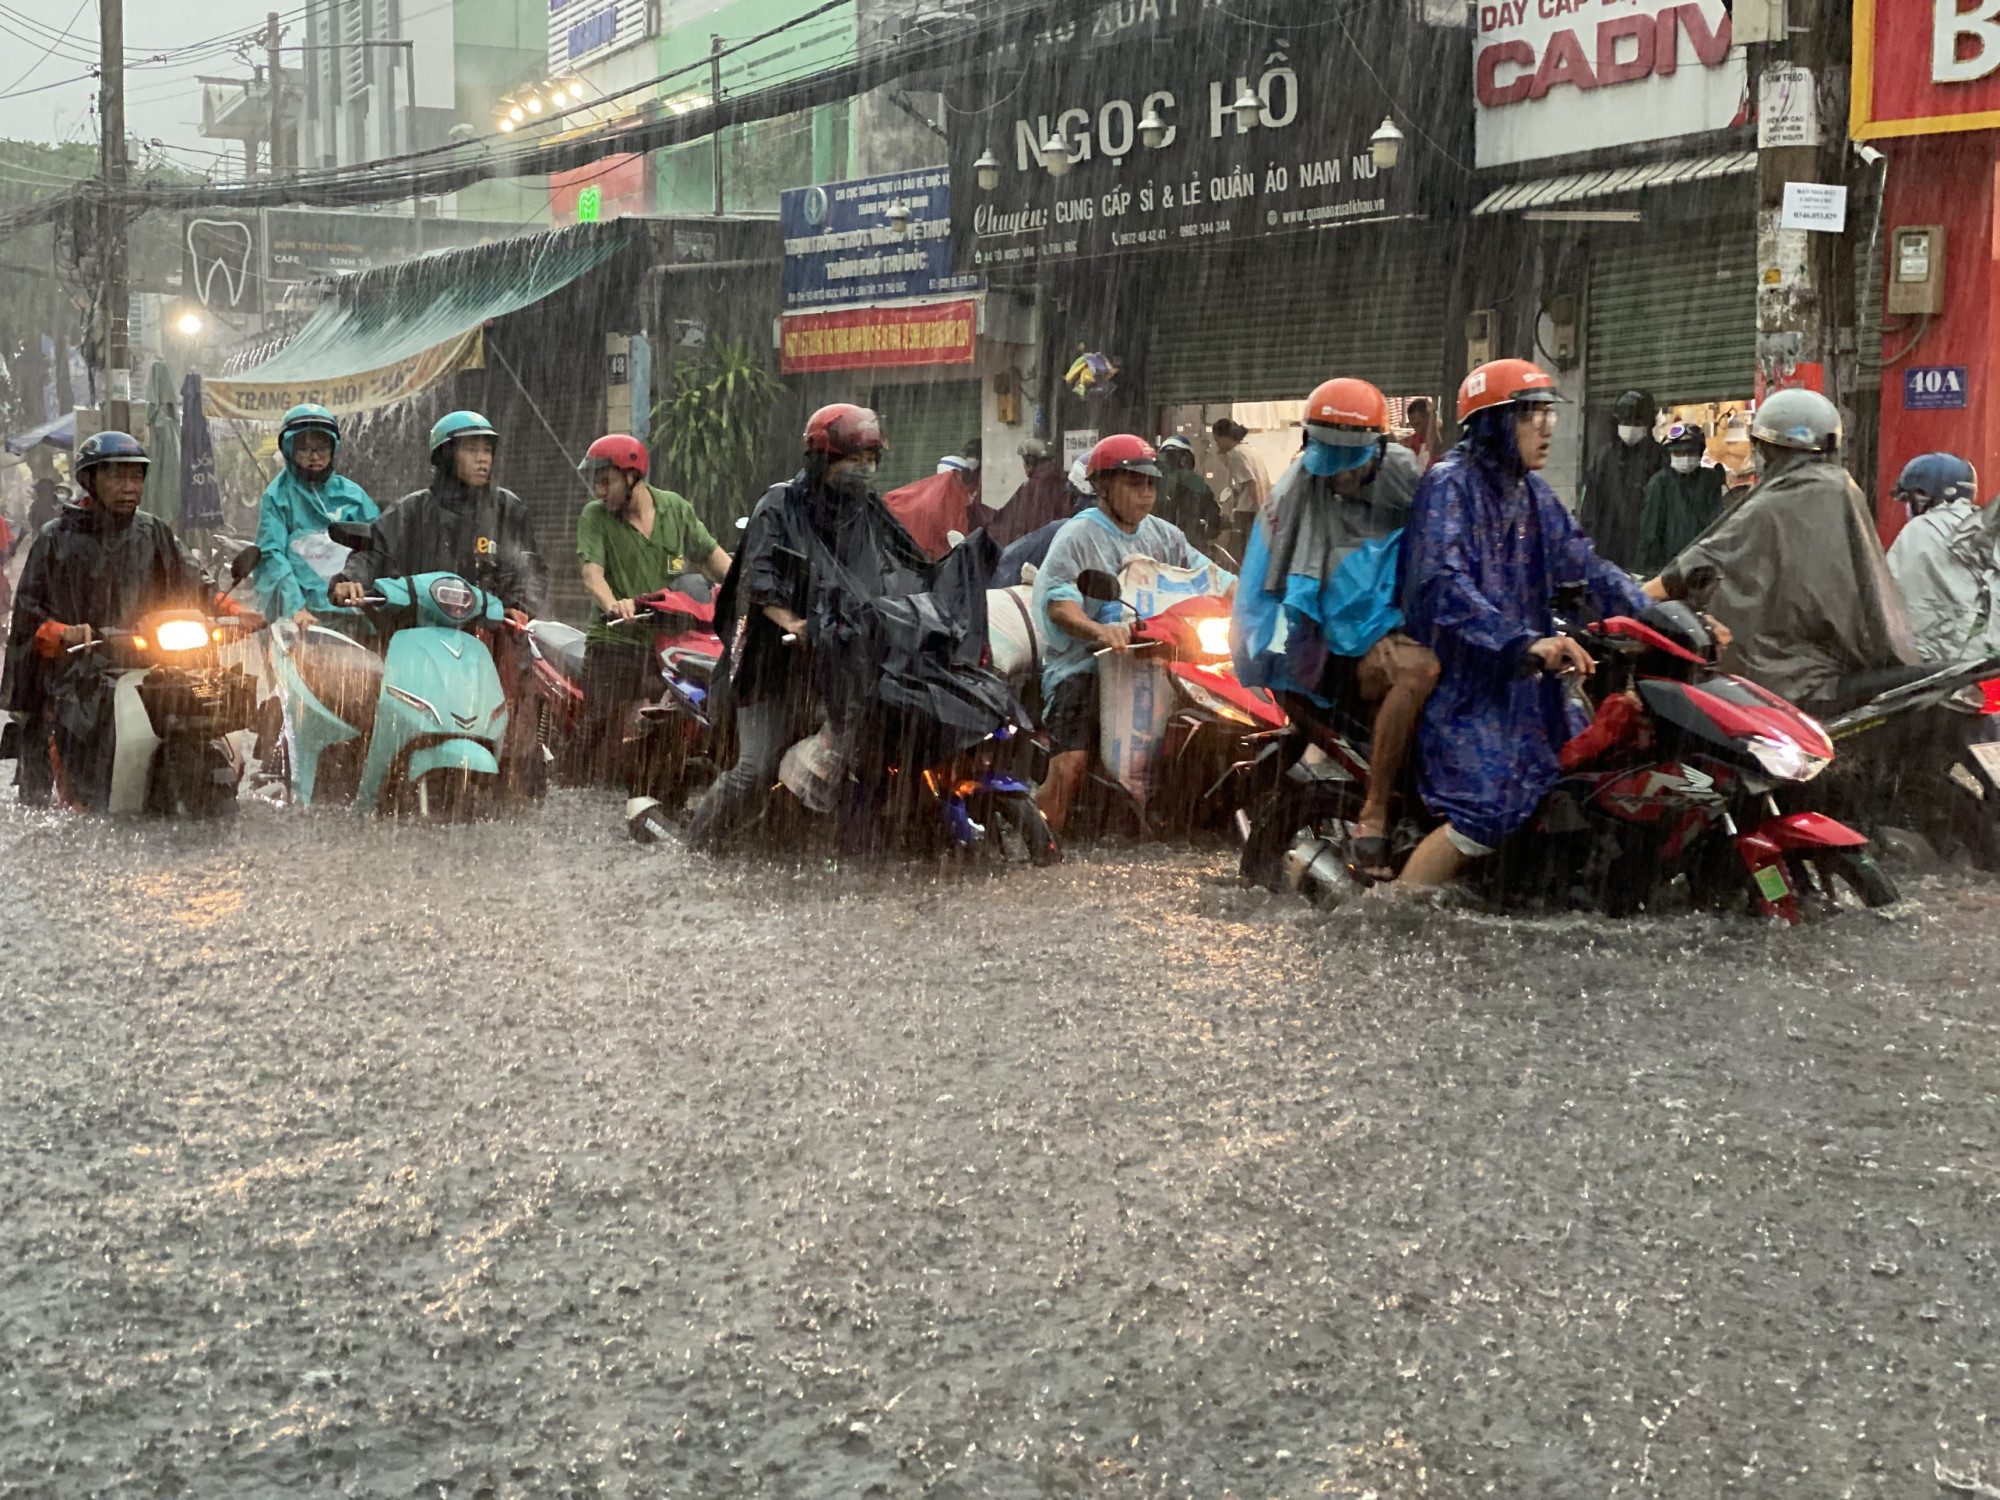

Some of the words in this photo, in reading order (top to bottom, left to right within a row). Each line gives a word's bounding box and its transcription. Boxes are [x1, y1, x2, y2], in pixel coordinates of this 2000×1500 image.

[1016, 91, 1176, 171] NGỌC
[1210, 38, 1298, 138] HỒ
[974, 203, 1048, 237] Chuyên:
[1055, 198, 1093, 223] CUNG
[1102, 184, 1131, 217] CẤP
[1140, 180, 1153, 212] SỈ
[1162, 185, 1174, 208] &
[1182, 171, 1201, 206] LẺ
[1210, 164, 1254, 202] QUẦN
[1265, 161, 1288, 194] ÁO
[1300, 159, 1340, 188] NAM
[329, 257, 355, 267] SINH
[1909, 370, 1961, 393] 40A
[235, 390, 291, 411] TRANG
